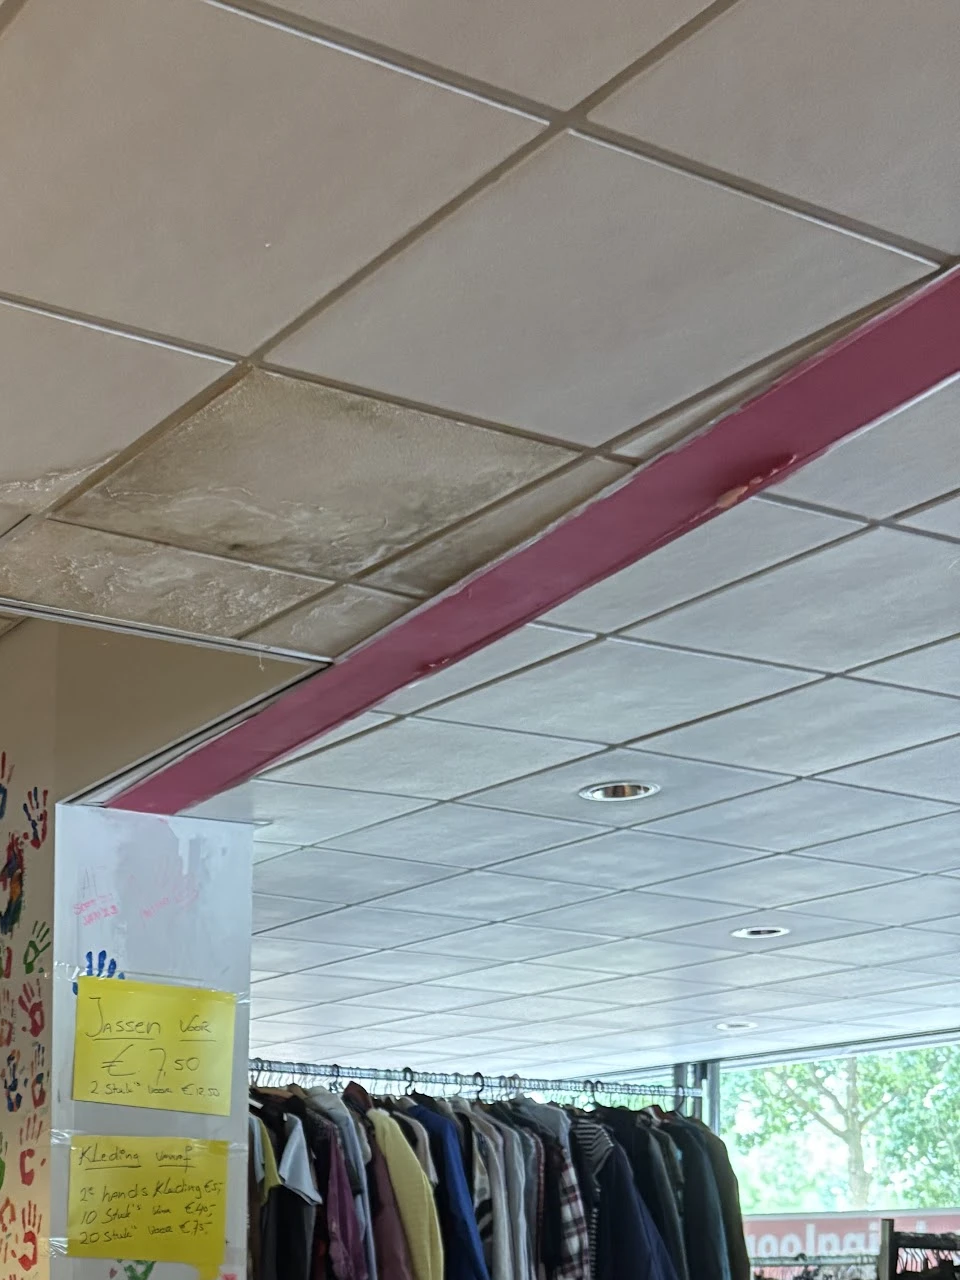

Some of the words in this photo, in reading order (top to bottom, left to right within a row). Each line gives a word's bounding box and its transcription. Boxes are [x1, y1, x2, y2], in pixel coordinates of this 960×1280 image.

[149, 1048, 200, 1086] 7,50
[90, 1081, 98, 1094] 2
[80, 1210, 97, 1224] 10
[80, 1231, 99, 1244] 20
